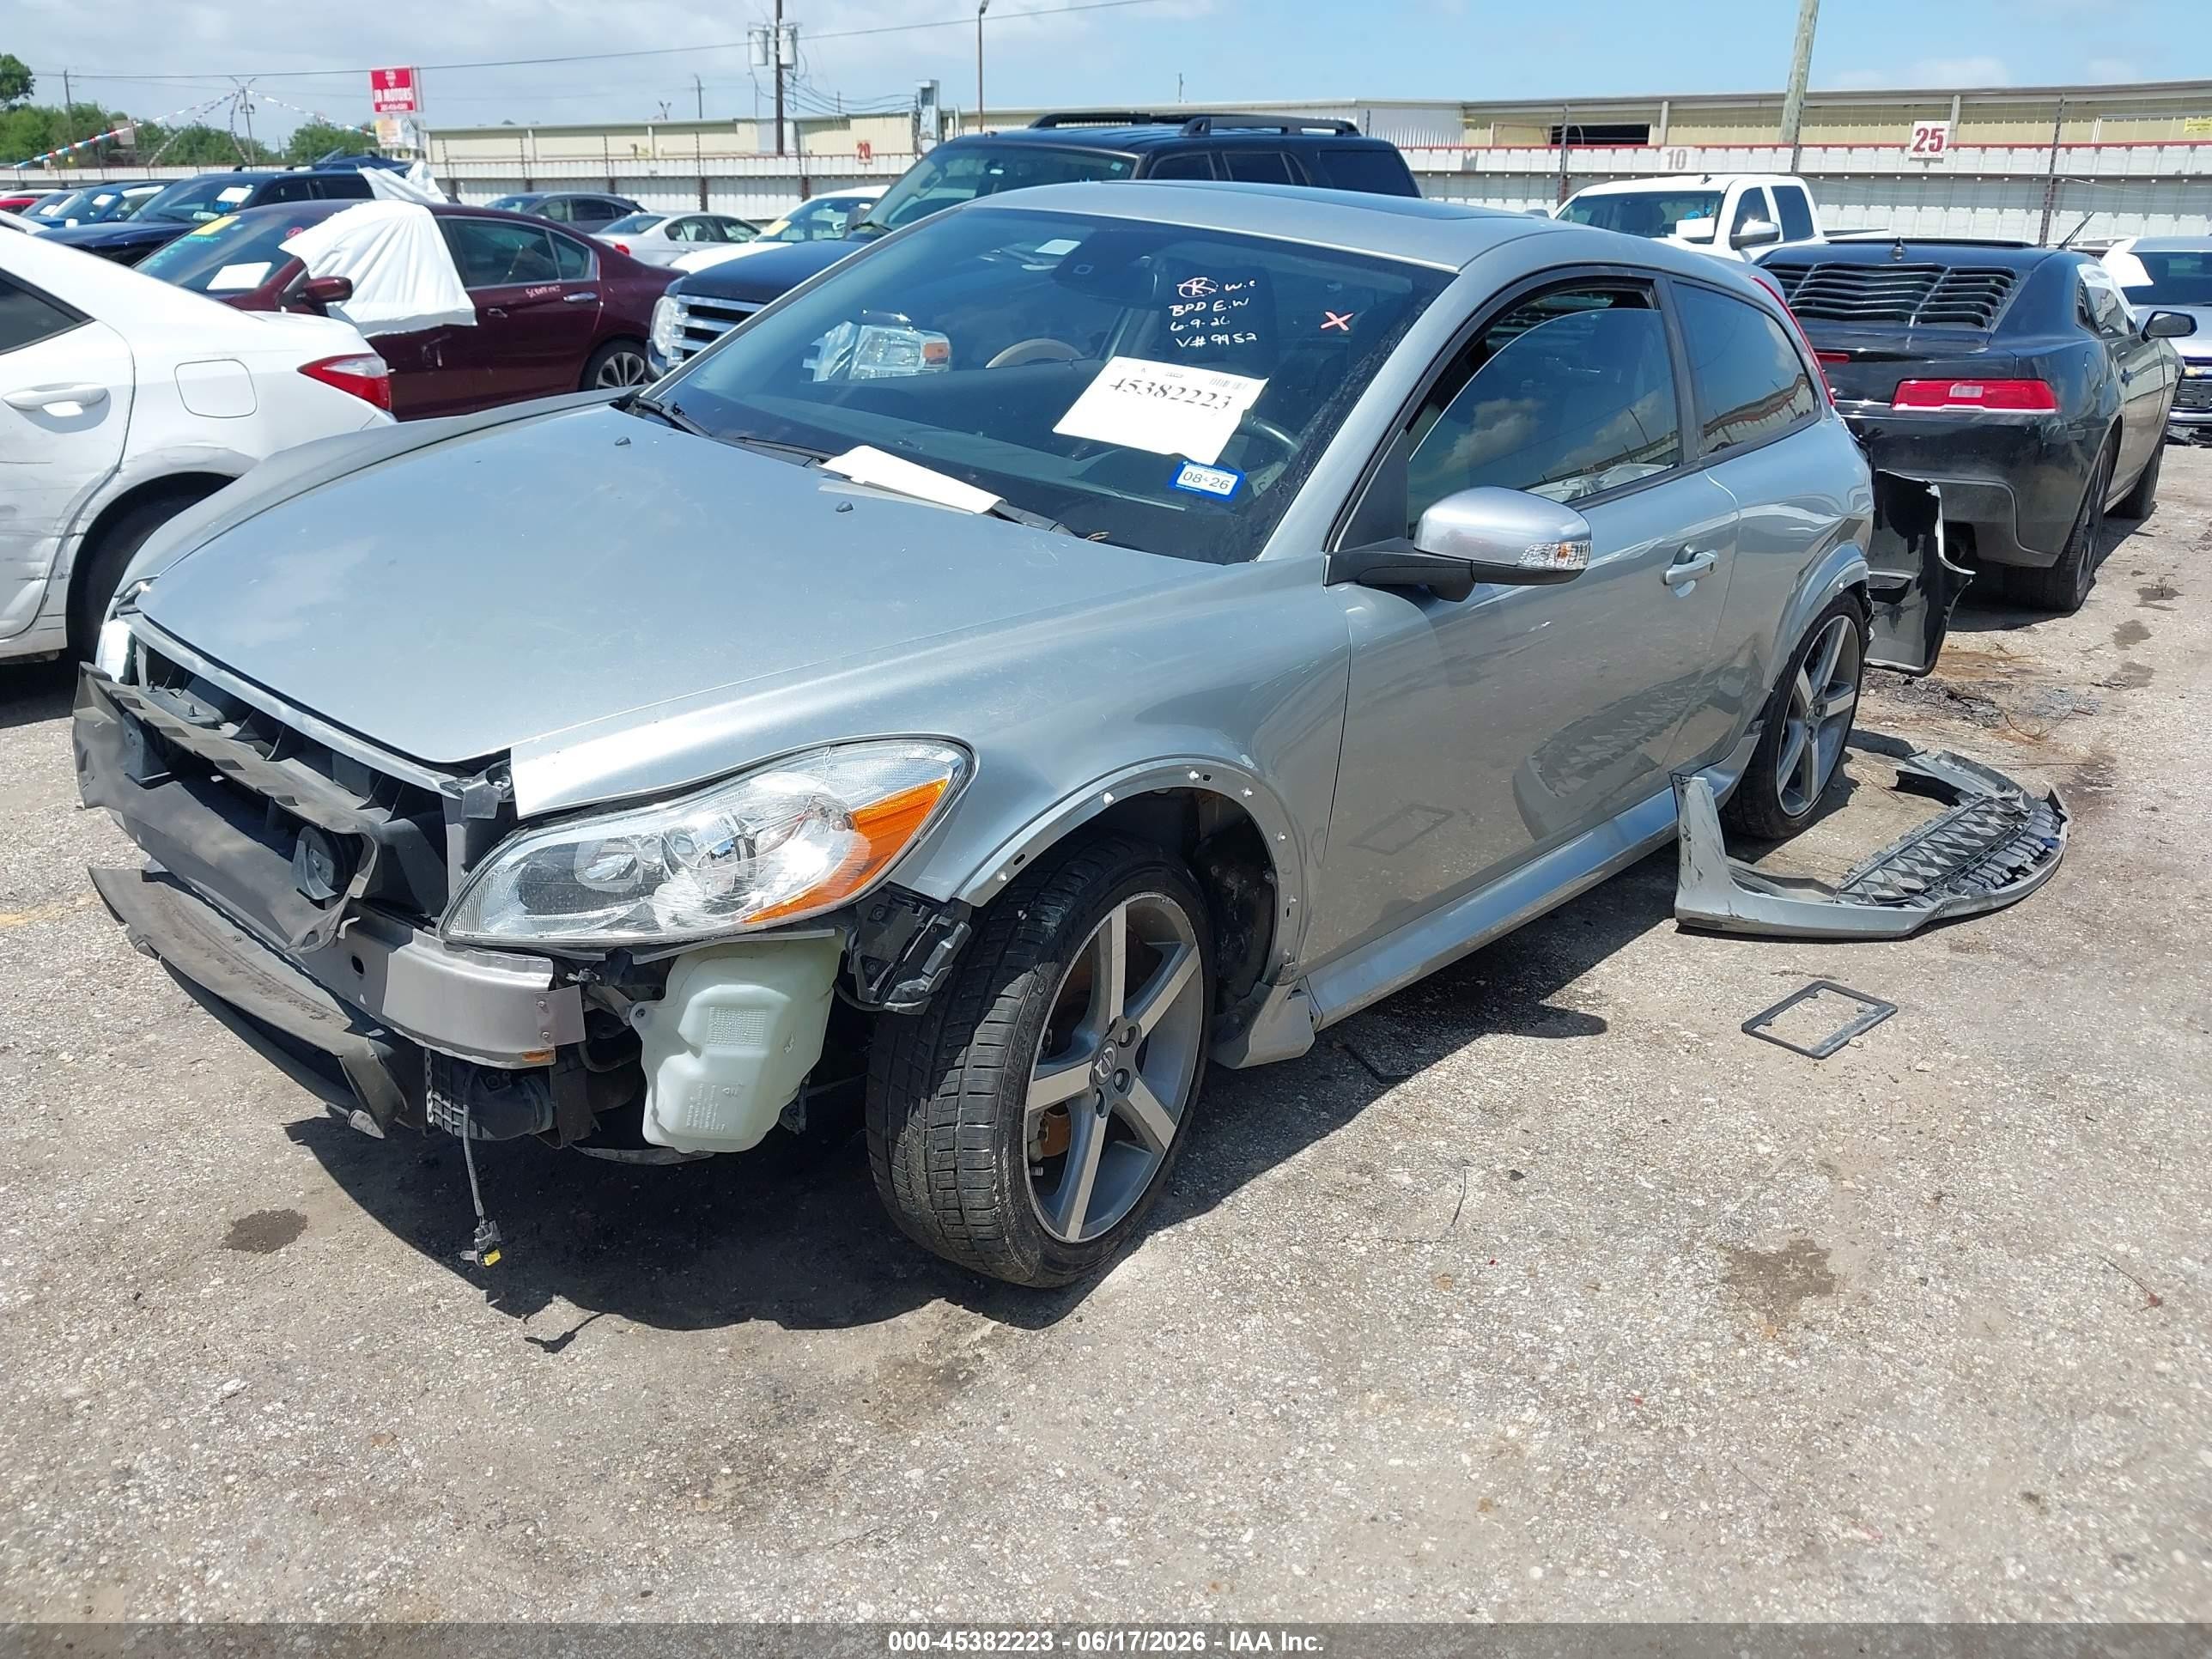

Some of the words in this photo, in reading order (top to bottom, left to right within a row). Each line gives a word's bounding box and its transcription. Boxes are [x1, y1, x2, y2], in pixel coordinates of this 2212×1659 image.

[857, 142, 871, 160] 20
[1912, 127, 1946, 154] 25
[1666, 149, 1687, 171] 10
[1109, 377, 1233, 410] 45382223
